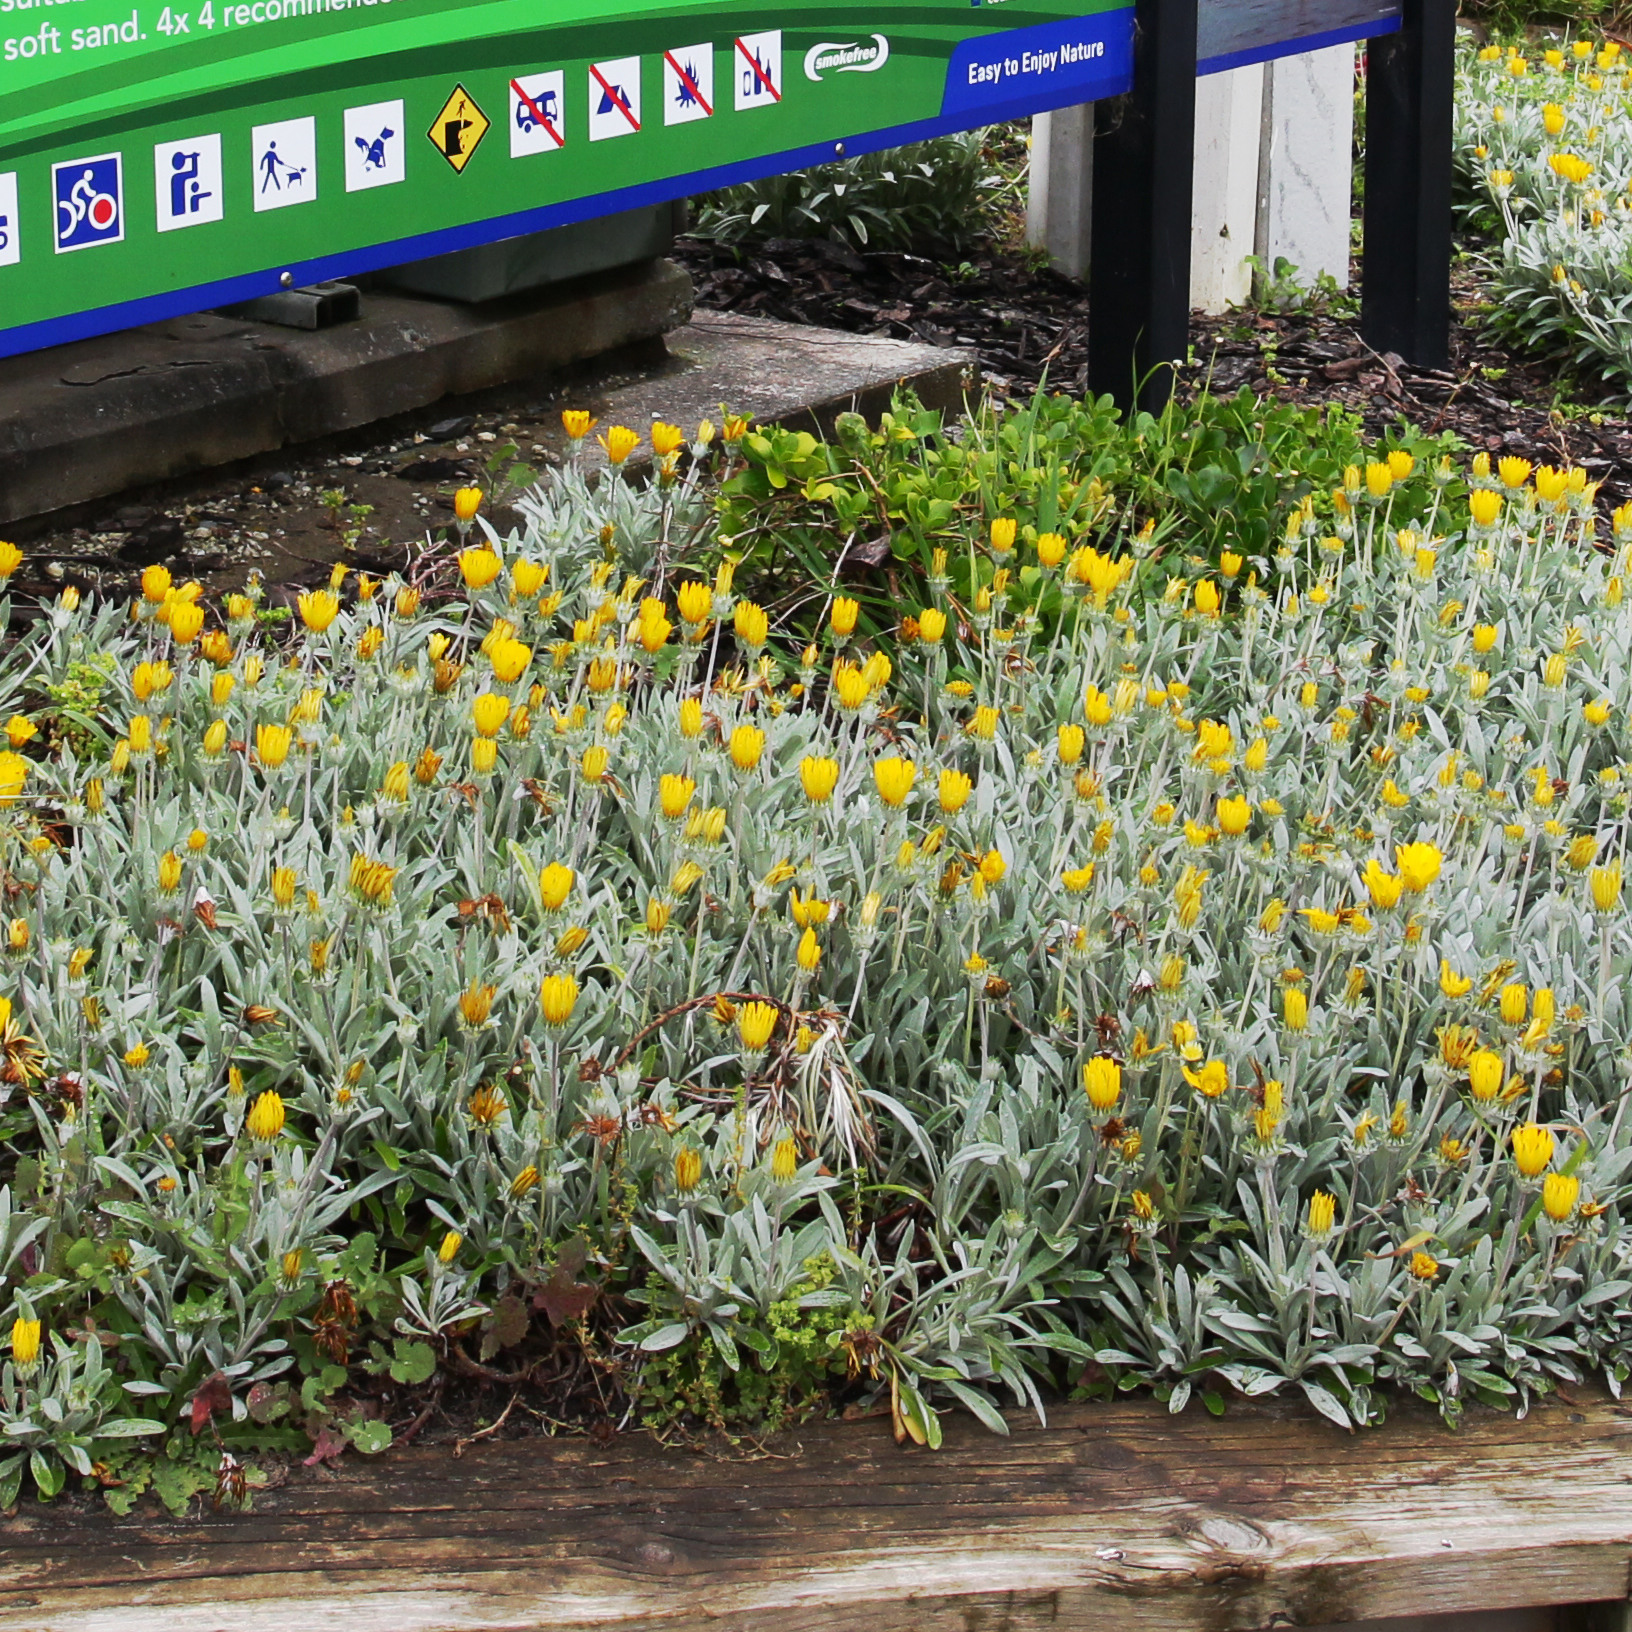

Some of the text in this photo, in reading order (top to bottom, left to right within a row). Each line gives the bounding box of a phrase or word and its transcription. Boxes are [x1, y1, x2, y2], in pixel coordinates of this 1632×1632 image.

[4, 22, 61, 60] soft
[71, 10, 146, 50] sand.
[157, 7, 190, 35] 4x
[198, 1, 215, 29] 4
[816, 47, 876, 69] smokefree
[969, 42, 1103, 84] Easy to Enjoy Nature
